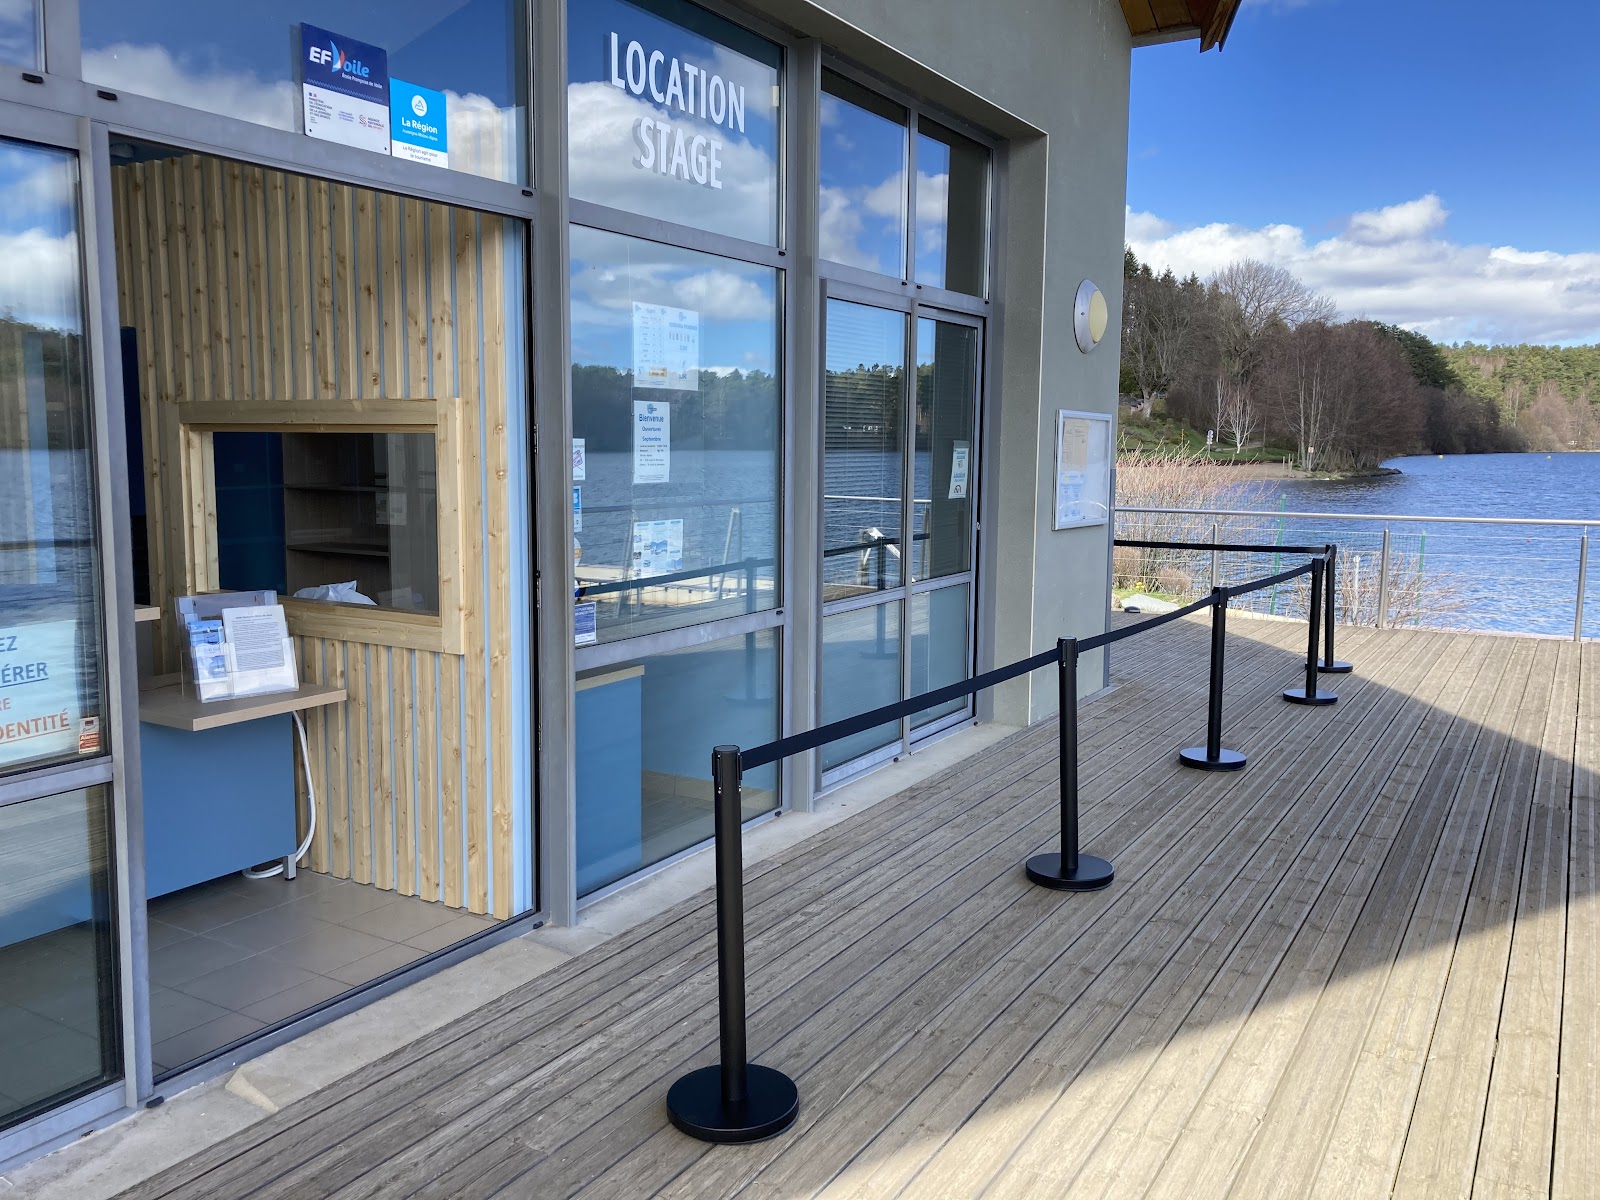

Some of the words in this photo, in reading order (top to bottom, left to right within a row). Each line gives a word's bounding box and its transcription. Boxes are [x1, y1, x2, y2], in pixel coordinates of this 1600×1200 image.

[610, 32, 745, 134] LOCATION
[401, 117, 411, 127] La
[412, 120, 438, 134] Région
[640, 116, 723, 189] STAGE
[639, 414, 664, 422] Bienvenue
[0, 698, 11, 711] E
